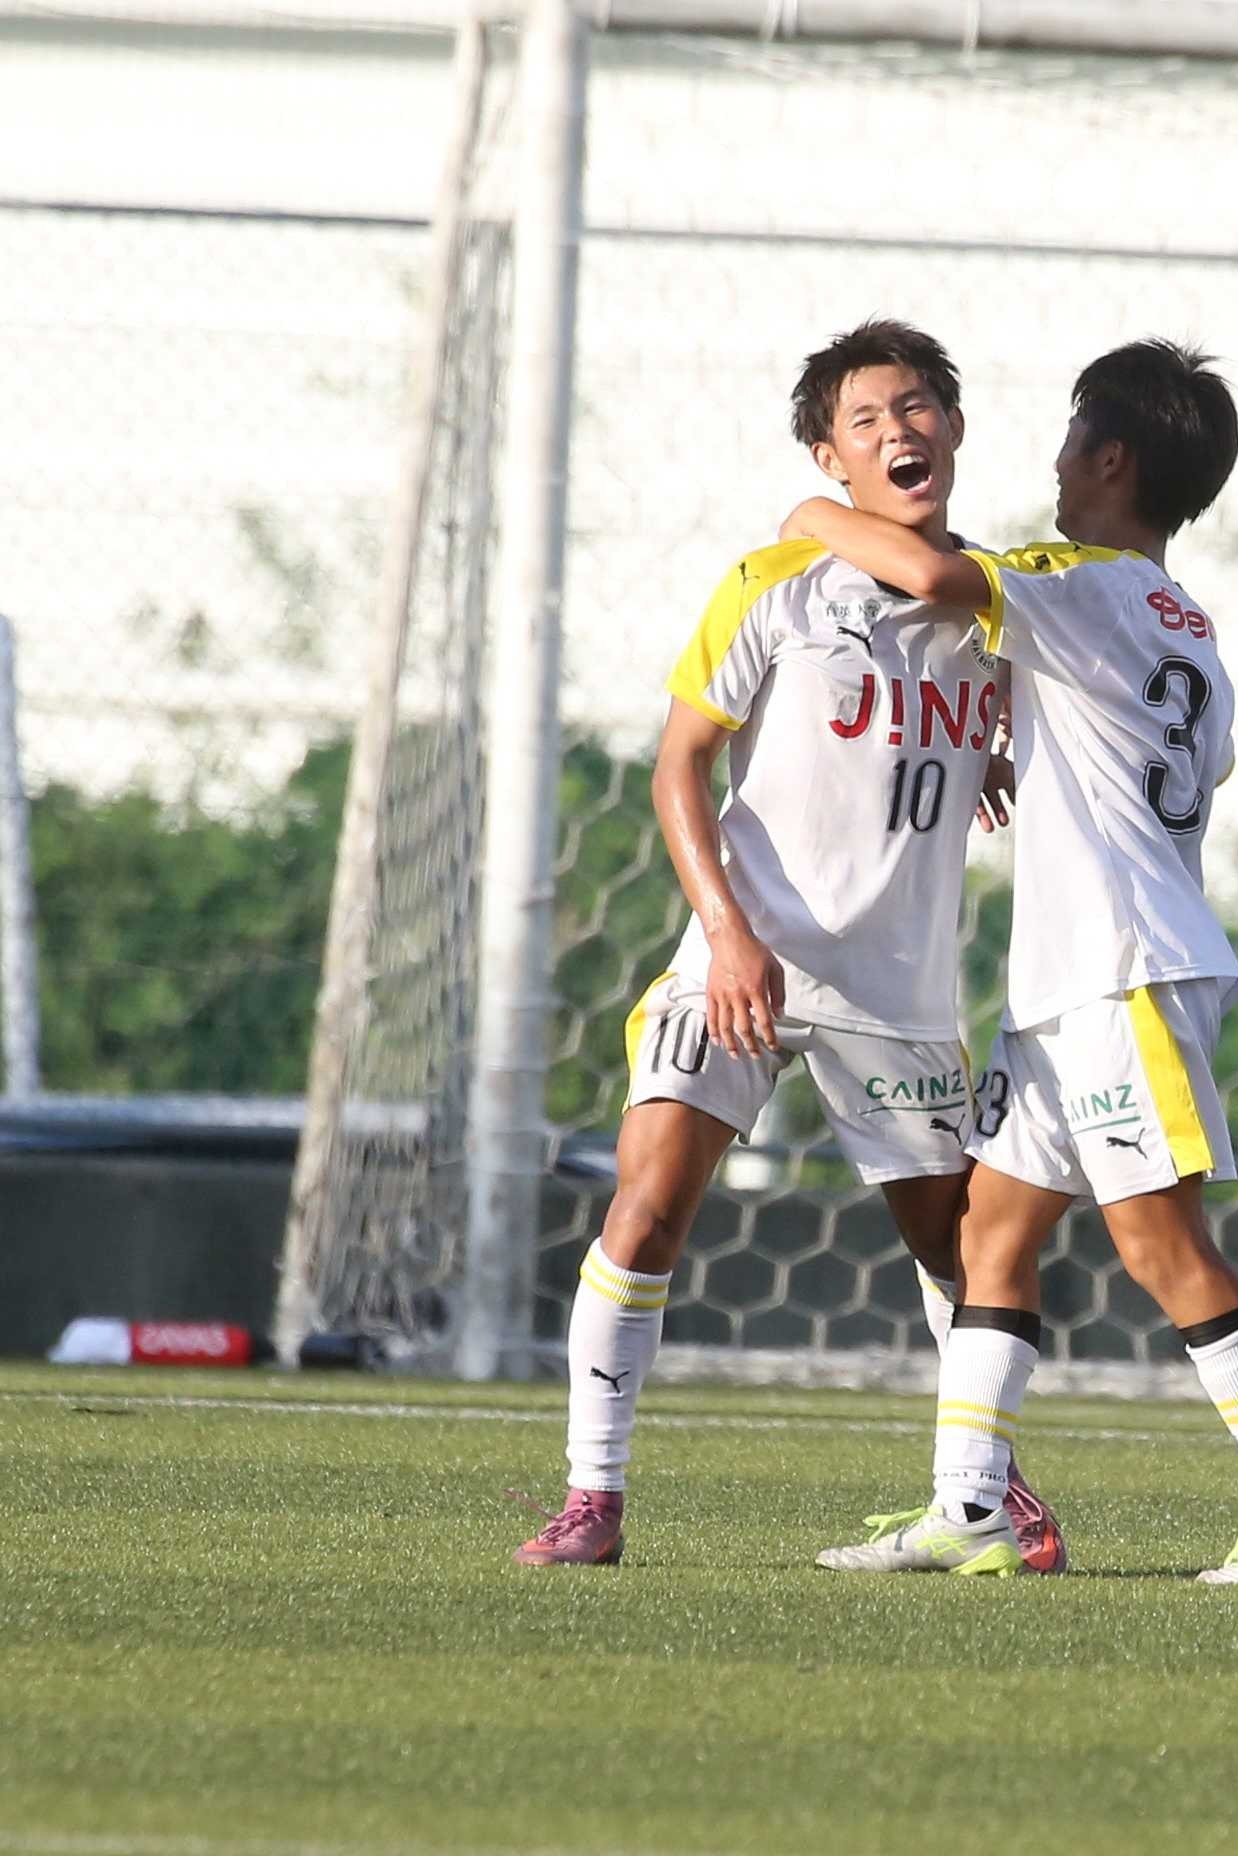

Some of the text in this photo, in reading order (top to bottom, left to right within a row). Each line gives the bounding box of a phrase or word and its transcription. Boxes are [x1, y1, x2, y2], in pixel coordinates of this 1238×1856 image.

[1143, 655, 1213, 835] 3
[887, 758, 946, 832] 10
[650, 1008, 709, 1074] 10
[865, 1069, 966, 1101] CAINZ
